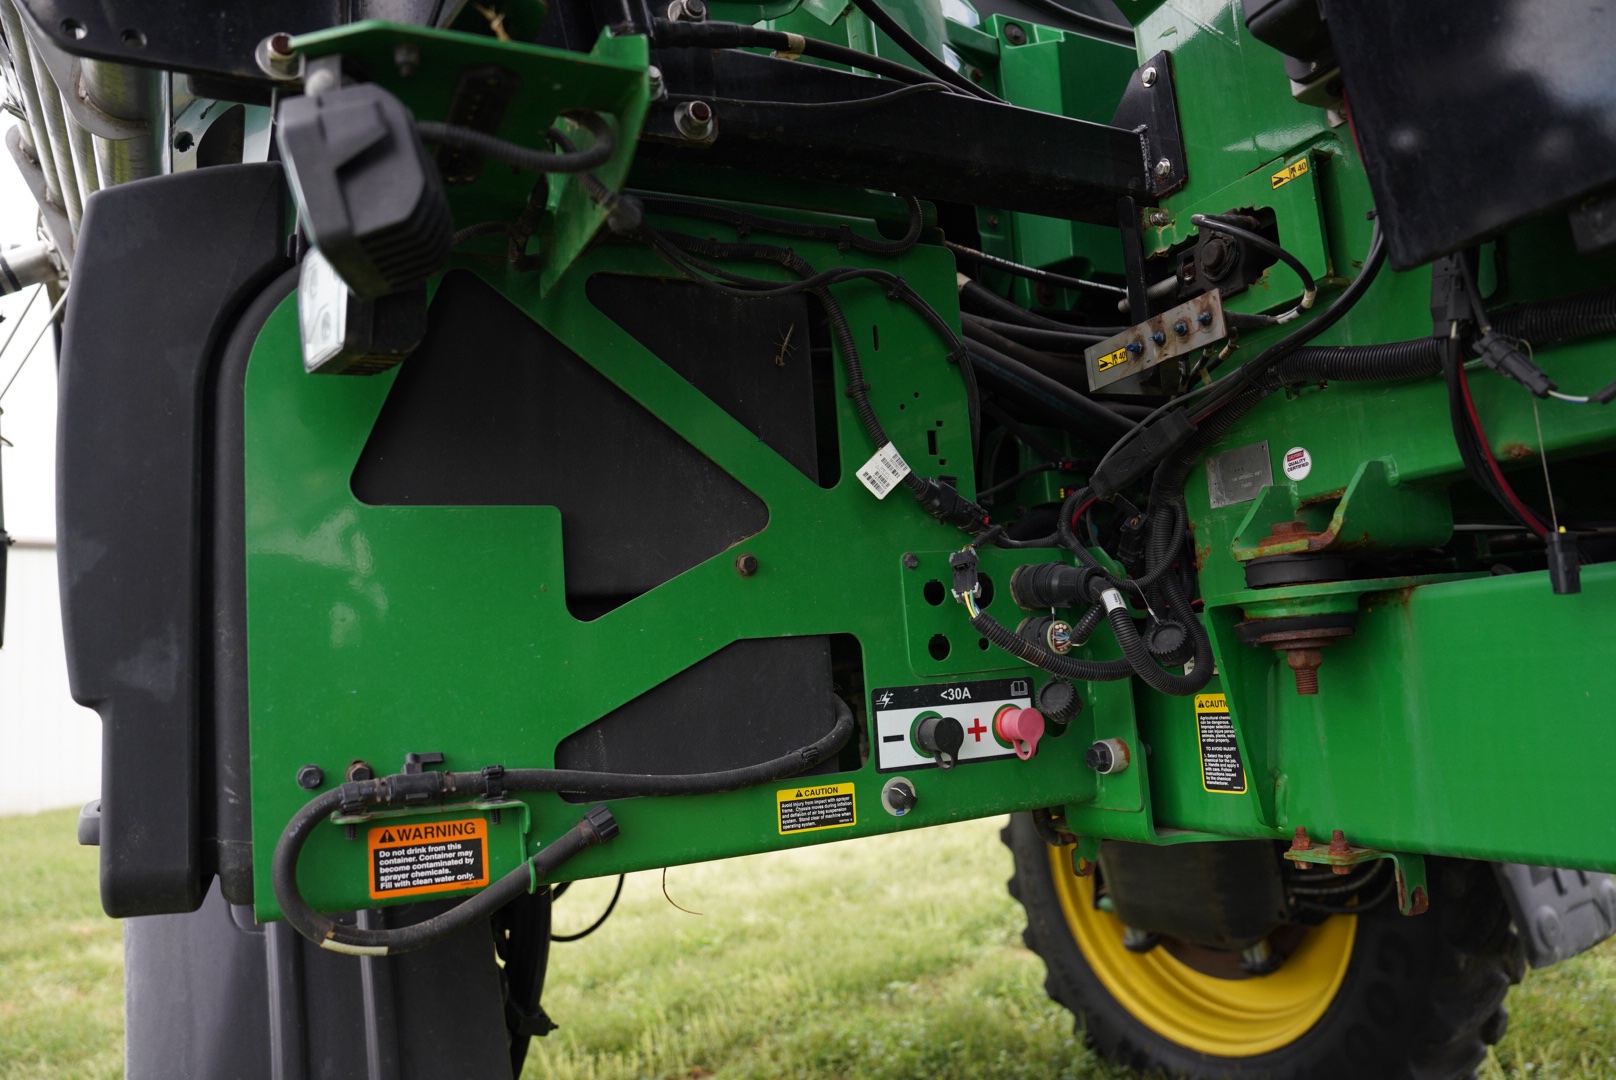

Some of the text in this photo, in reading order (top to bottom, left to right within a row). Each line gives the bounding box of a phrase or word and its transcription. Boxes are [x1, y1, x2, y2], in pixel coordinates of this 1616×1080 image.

[1298, 162, 1306, 171] 40
[1118, 351, 1126, 360] 40
[1287, 462, 1309, 472] CERTIFIED
[1288, 458, 1306, 466] QUALITY
[940, 686, 971, 701] <30A
[805, 787, 838, 796] CAUTION
[397, 822, 476, 841] WARNING
[379, 856, 417, 866] container.
[419, 852, 455, 861] Container
[380, 865, 410, 874] become
[412, 858, 463, 870] contaminated
[380, 868, 451, 882] sprayer chemicals.
[394, 880, 410, 888] with
[435, 875, 455, 883] water
[457, 872, 474, 880] only.
